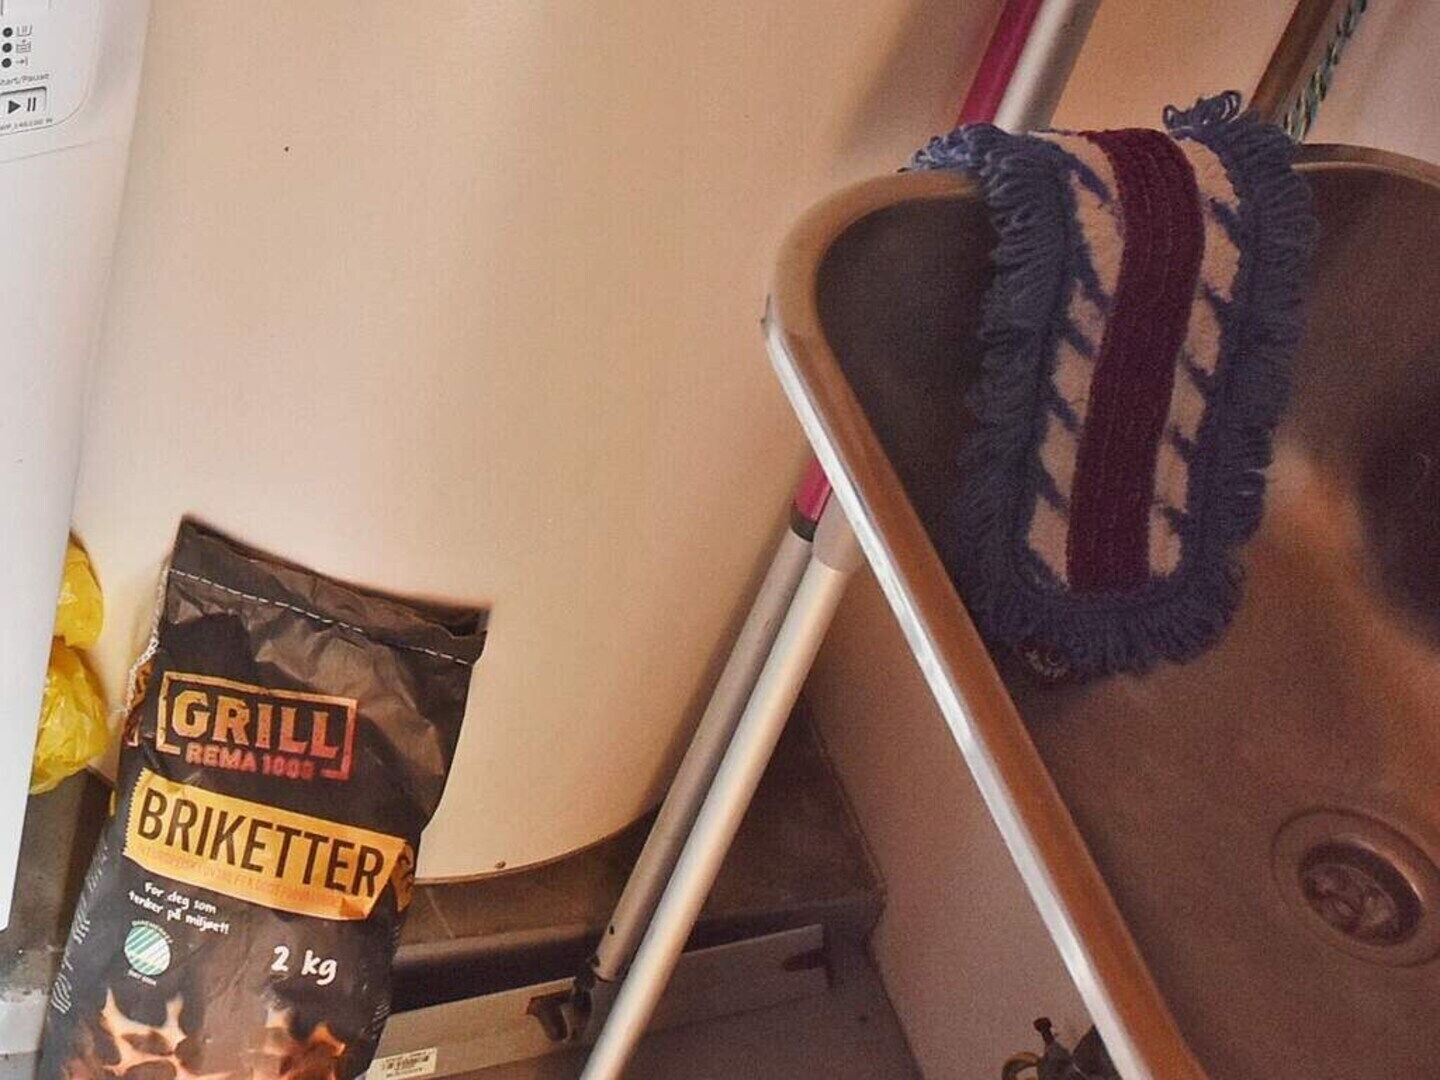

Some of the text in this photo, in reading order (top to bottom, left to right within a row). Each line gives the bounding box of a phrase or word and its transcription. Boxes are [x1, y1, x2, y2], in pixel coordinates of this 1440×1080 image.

[172, 689, 339, 759] GRILL
[185, 741, 317, 781] REMA 1000
[137, 787, 385, 898] BRIKETTER
[128, 890, 164, 914] tenker
[166, 908, 182, 922] på
[145, 882, 217, 915] For deg som
[271, 945, 338, 986] 2 kg
